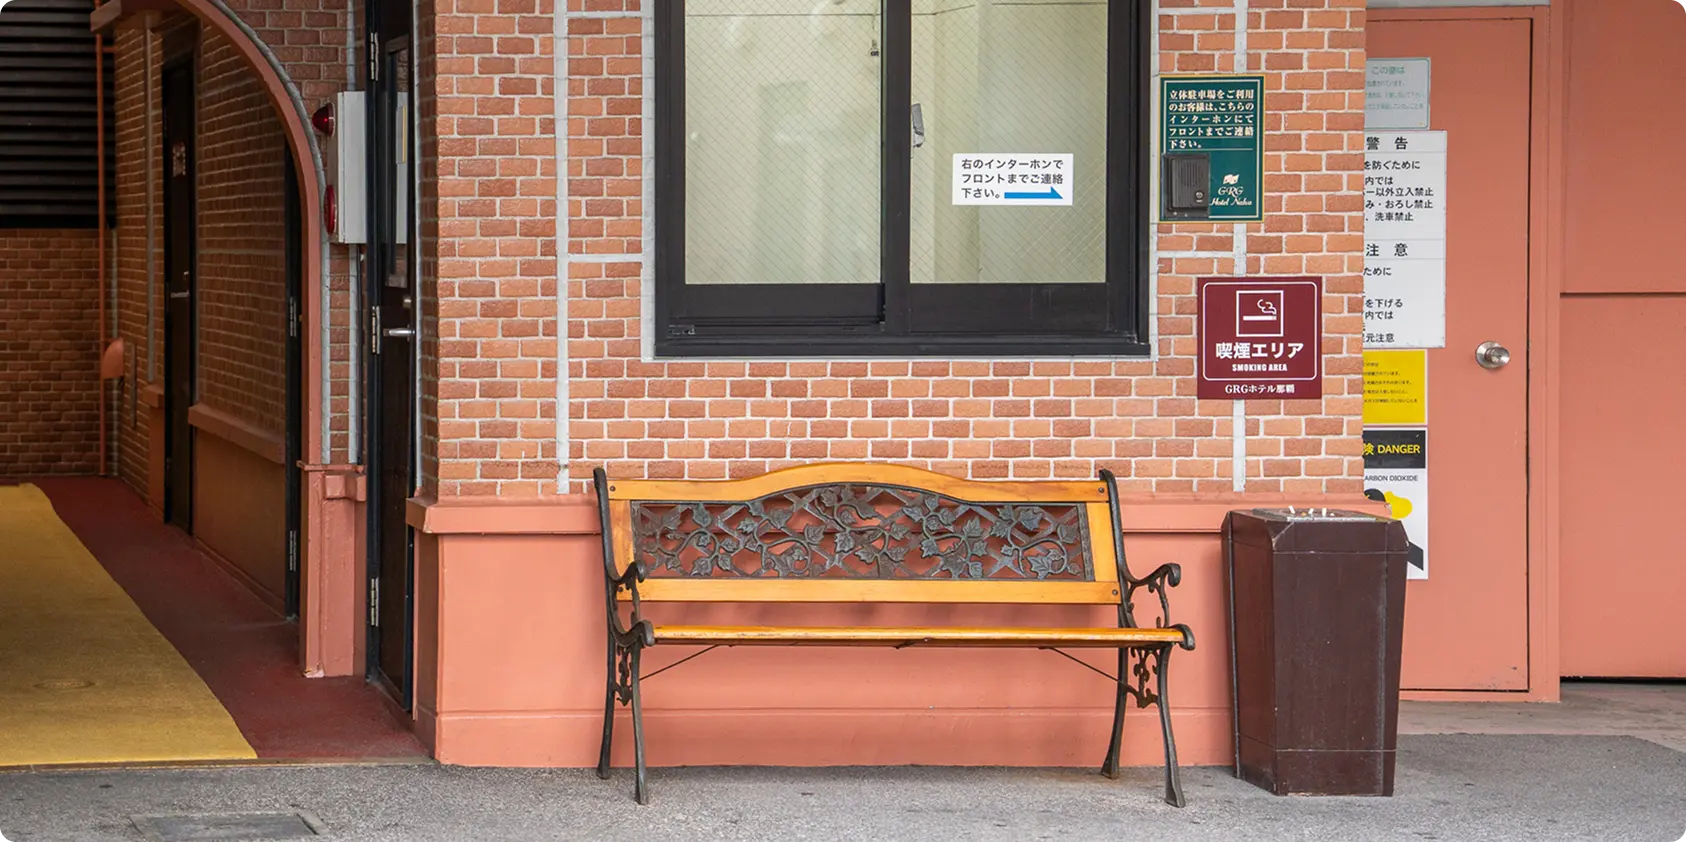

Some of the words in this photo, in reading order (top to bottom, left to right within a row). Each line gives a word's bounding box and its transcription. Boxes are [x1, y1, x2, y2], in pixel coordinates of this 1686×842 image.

[1169, 89, 1255, 100] 立体駐車場をご利用
[1168, 102, 1255, 112] のお客様は、こちらの
[1168, 114, 1255, 124] インターホンにて
[1169, 126, 1254, 137] フロントまでご連絡
[1169, 140, 1202, 149] 下さい。
[961, 158, 1064, 170] 右のインターホンで
[1364, 160, 1420, 170] を防ぐために
[962, 173, 1064, 185] フロントまでご連絡
[1364, 176, 1393, 186] 内では
[961, 187, 1000, 199] 下さい。
[1362, 187, 1434, 197] ー以外立入禁止
[1363, 267, 1392, 276] ために
[1365, 298, 1403, 308] を下げる
[1363, 333, 1395, 343] 元注意
[1215, 342, 1304, 359] 喫煙エリア
[1232, 363, 1267, 372] SMOKING
[1268, 363, 1288, 372] AREA
[1377, 444, 1421, 455] DANGER
